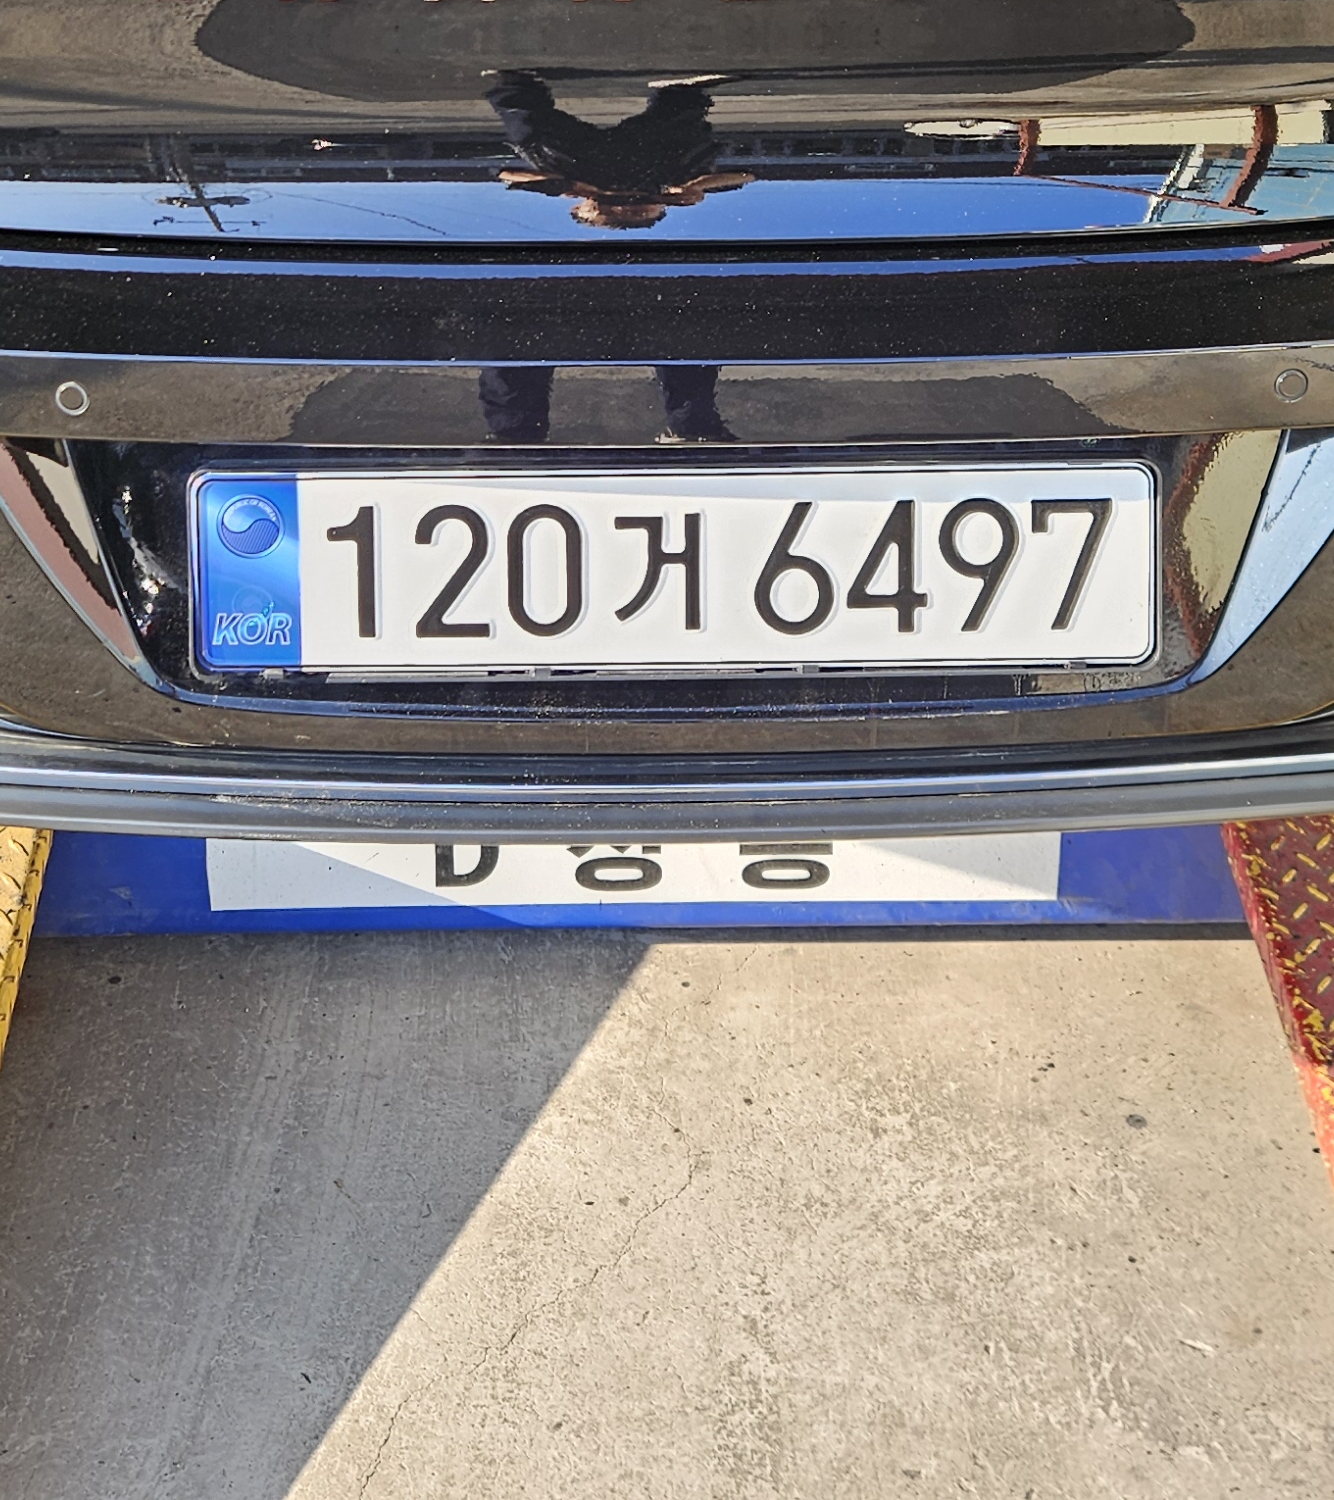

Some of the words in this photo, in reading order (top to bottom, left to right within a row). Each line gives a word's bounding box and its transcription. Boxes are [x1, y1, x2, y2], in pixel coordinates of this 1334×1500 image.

[325, 499, 704, 639] 120거
[753, 496, 1113, 636] 6497
[211, 611, 293, 646] KOR
